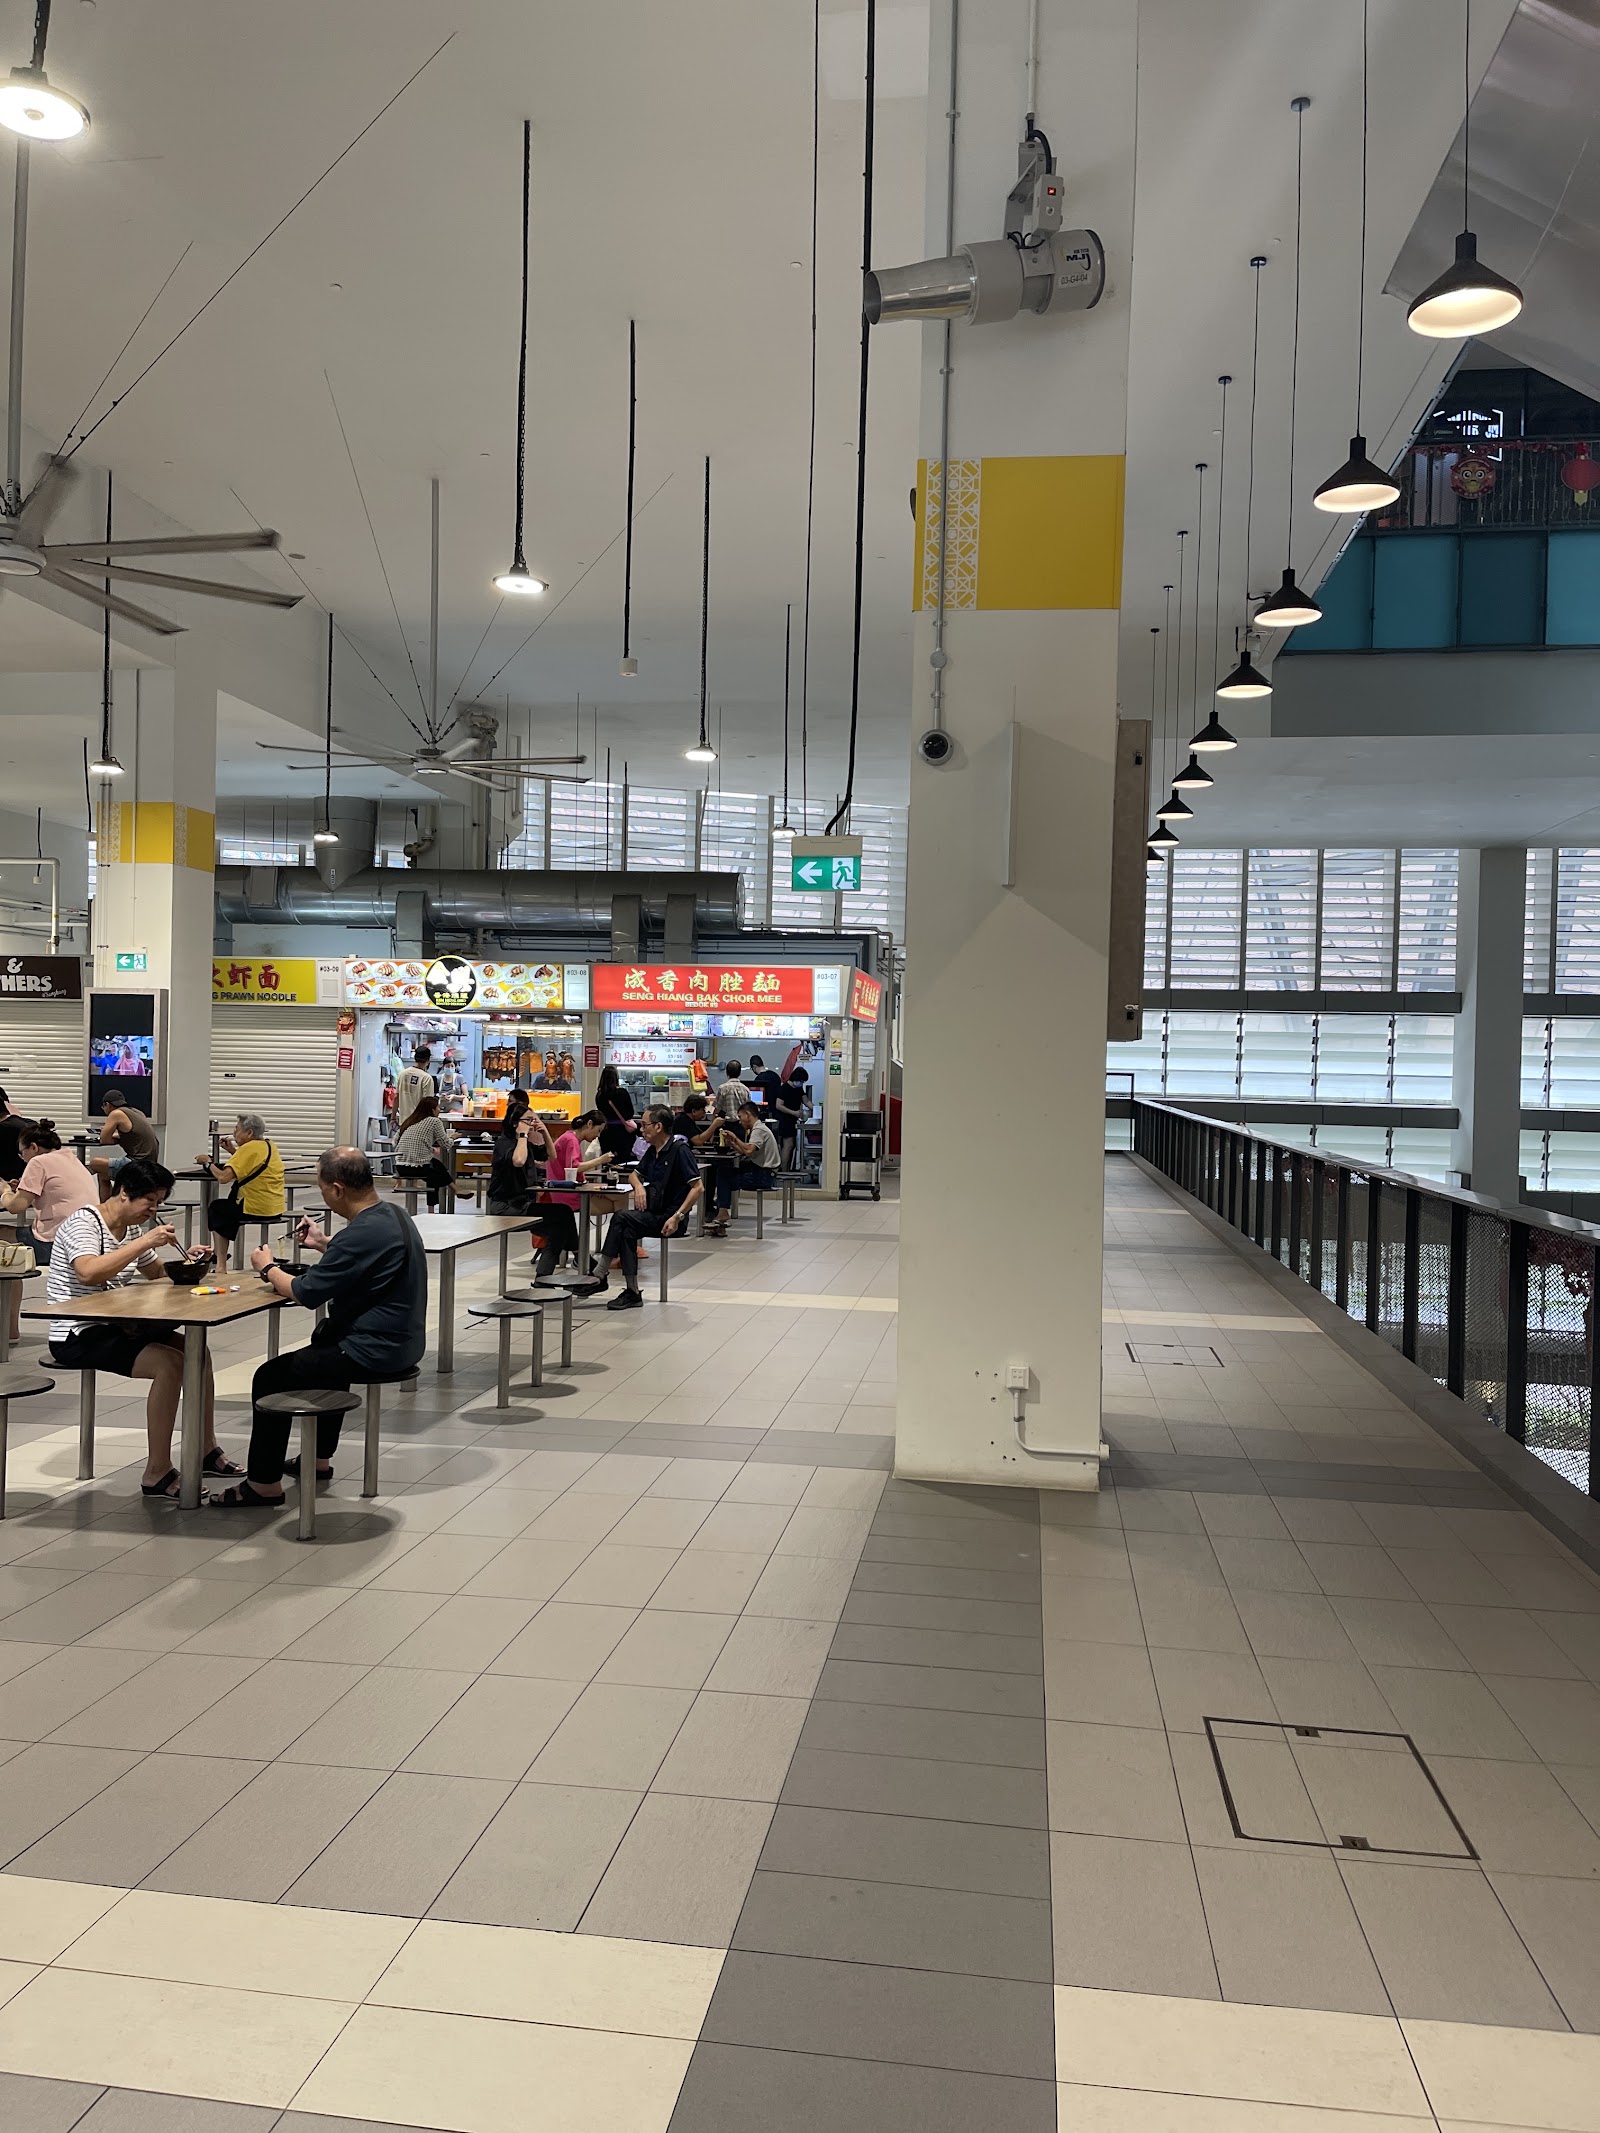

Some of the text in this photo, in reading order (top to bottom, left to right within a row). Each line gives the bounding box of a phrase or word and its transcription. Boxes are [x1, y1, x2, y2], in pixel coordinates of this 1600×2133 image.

[1061, 274, 1088, 284] 03-G4-04
[7, 958, 23, 973] &
[0, 974, 53, 992] HERS
[221, 991, 255, 1000] PRAWN
[257, 993, 297, 1002] NOODLE
[622, 992, 783, 1003] SENG HIANG BAK CHOR MEE
